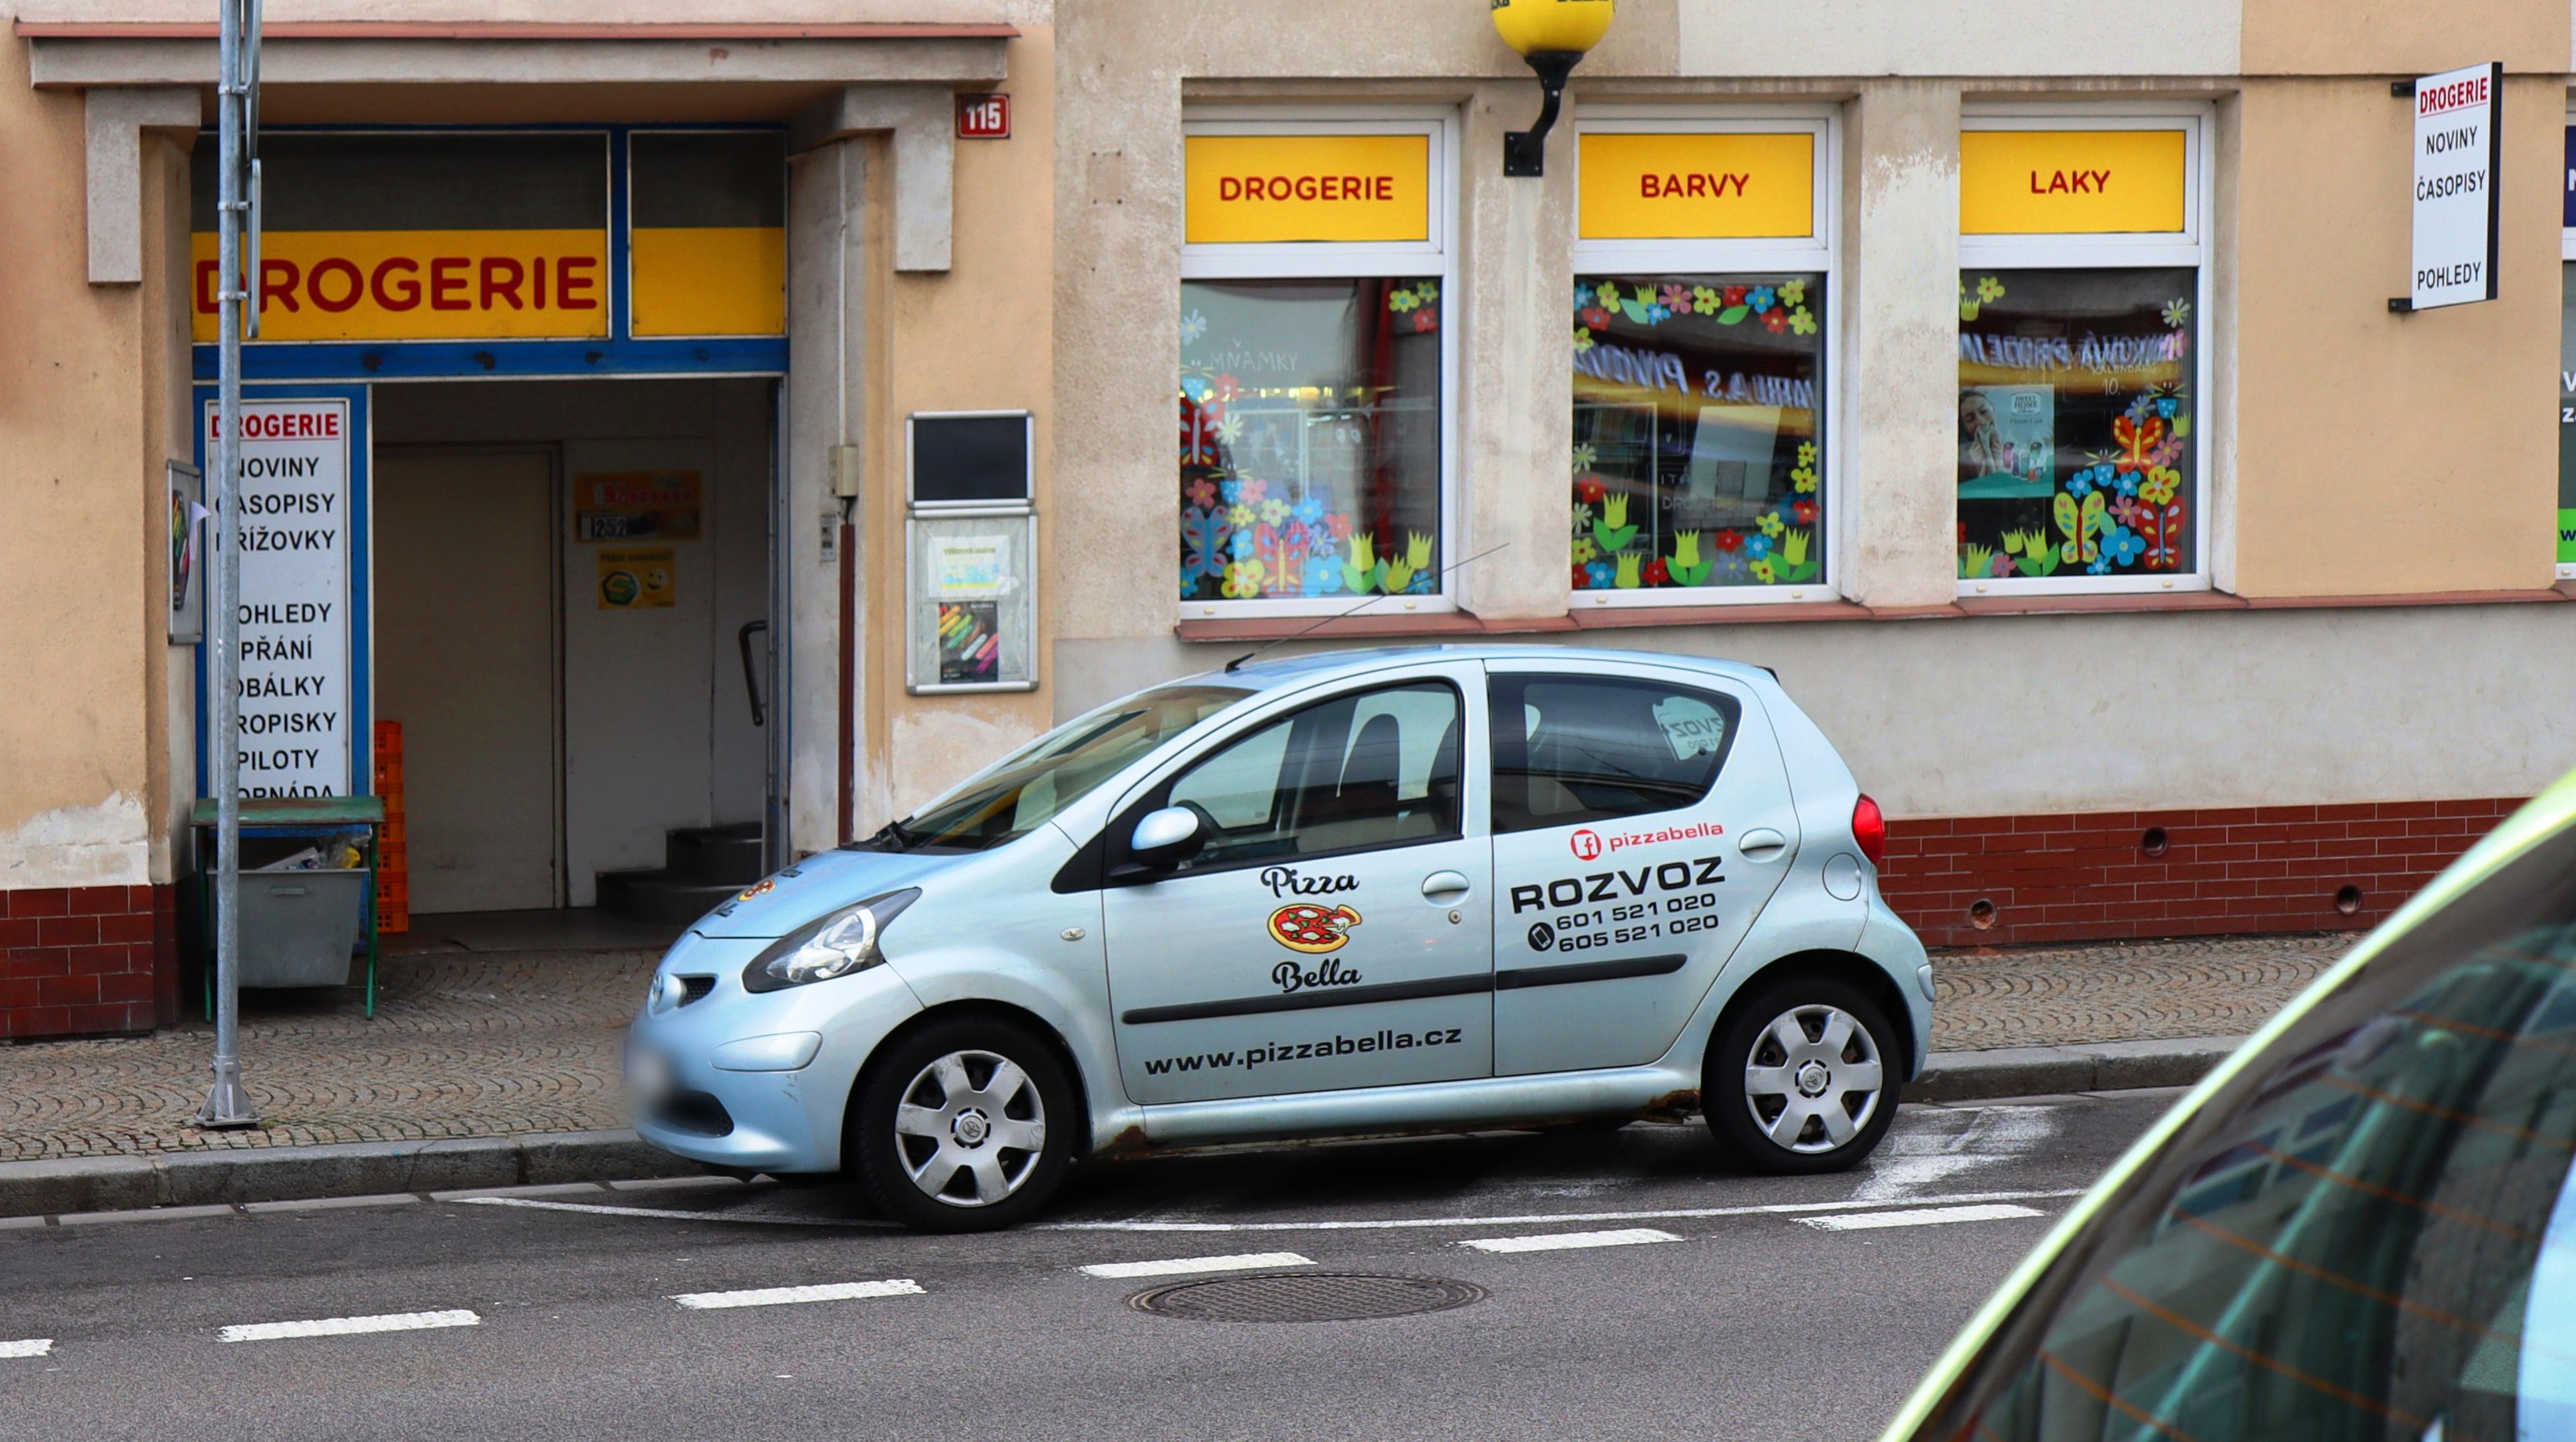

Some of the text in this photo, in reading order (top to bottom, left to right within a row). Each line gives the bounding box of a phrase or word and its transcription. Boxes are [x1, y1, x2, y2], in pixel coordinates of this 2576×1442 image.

[2420, 76, 2488, 114] DROGERIE
[966, 101, 1001, 130] 115
[2426, 125, 2478, 155] NOVINY
[1219, 176, 1394, 201] DROGERIE
[1641, 173, 1750, 198] BARVY
[2030, 169, 2111, 194] LAKY
[2416, 169, 2486, 202] ČASOPISY
[2417, 261, 2481, 291] POHLEDY
[211, 414, 339, 438] OGERIE
[216, 494, 335, 515] SOPISY
[216, 526, 336, 552] ÍŽOVKY
[239, 603, 332, 624] OHLEDY
[241, 635, 312, 661] PŘÁNÍ
[239, 712, 337, 734] ROPISKY
[1609, 822, 1724, 851] pizzabella
[1260, 866, 1360, 898] Pizza
[1511, 856, 1726, 914] ROZVOZ
[1556, 893, 1716, 930] 601 521 020
[1558, 914, 1718, 952] 605 521 020
[1272, 958, 1362, 993] Bella
[1144, 1028, 1462, 1076] www.pizzabella.cz
